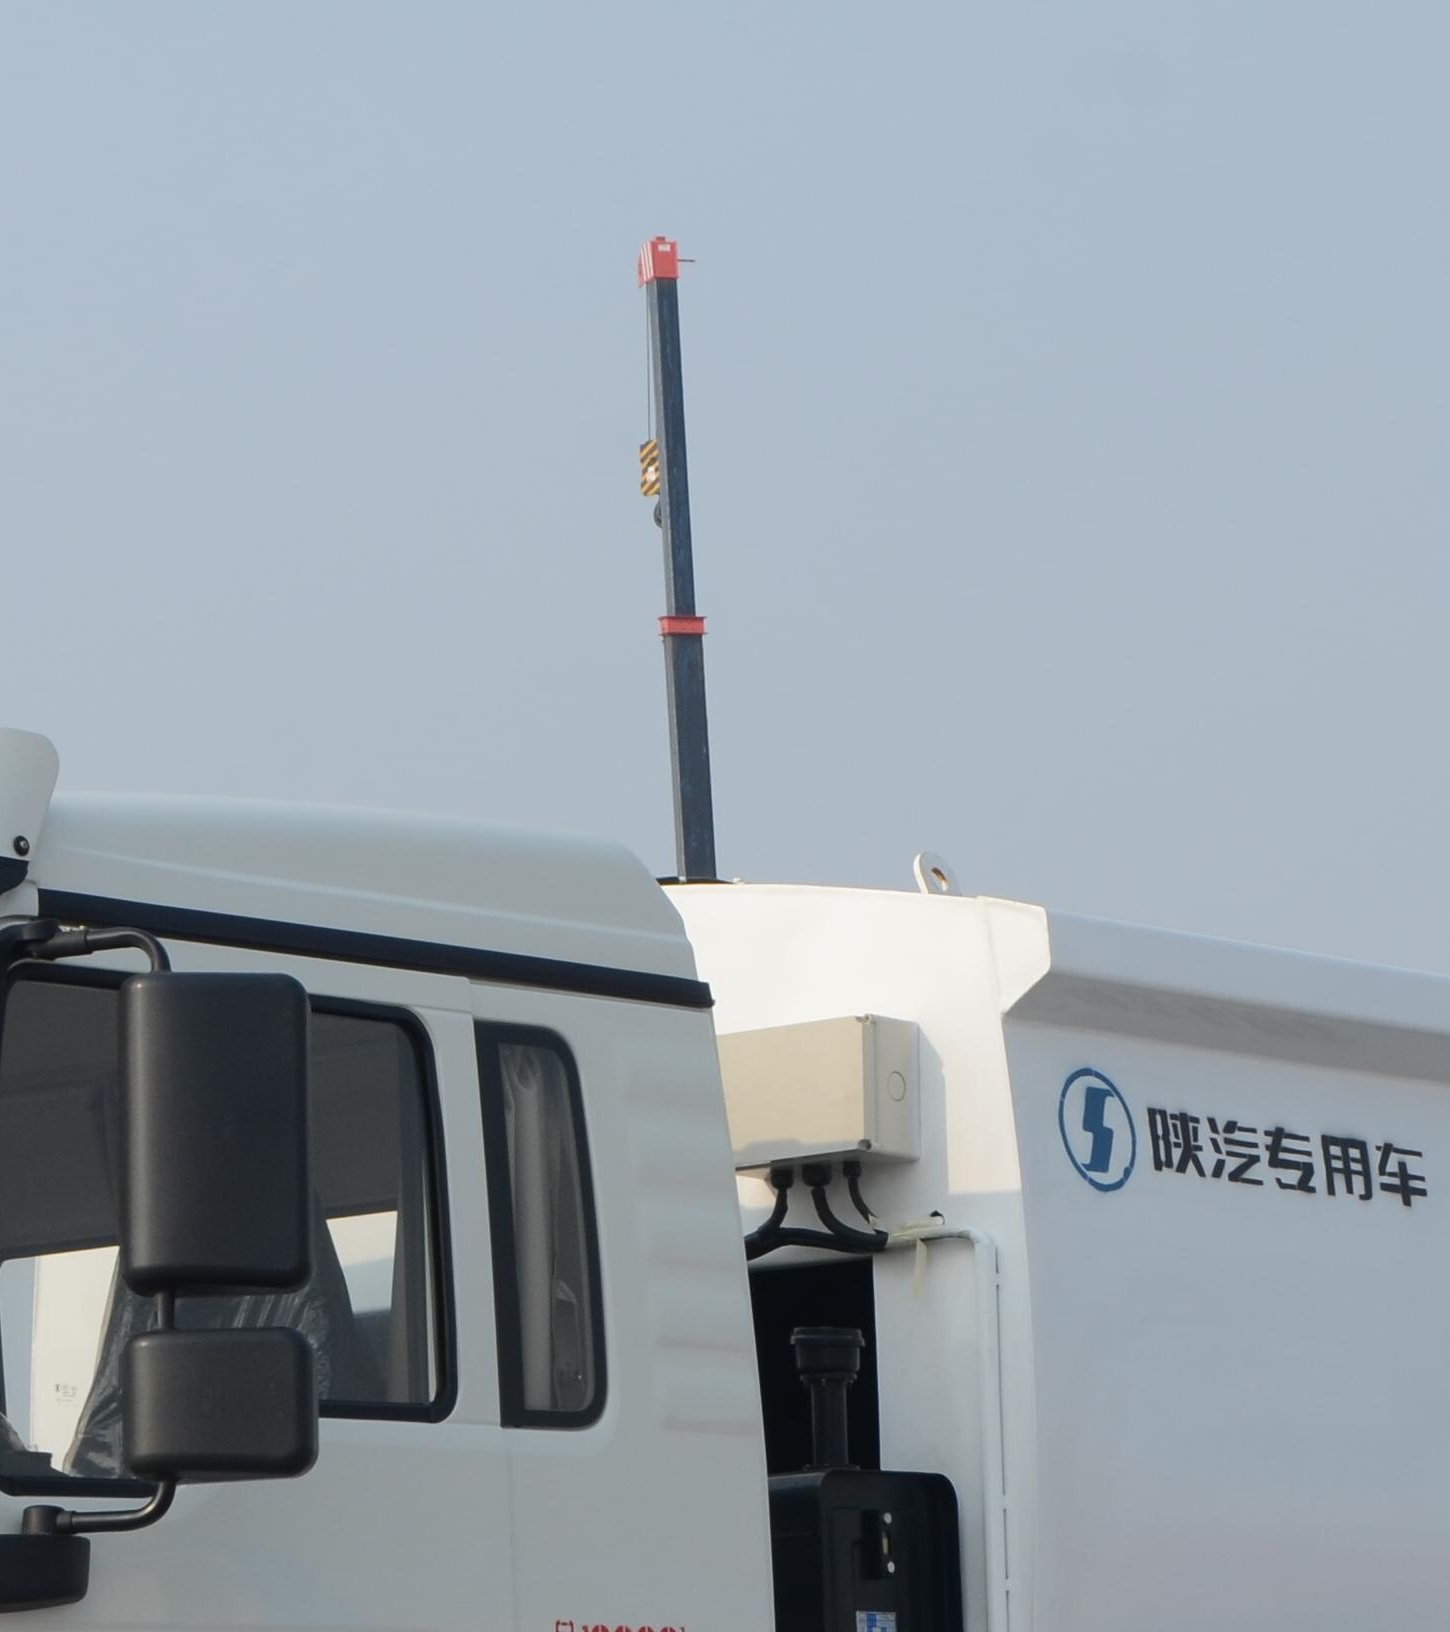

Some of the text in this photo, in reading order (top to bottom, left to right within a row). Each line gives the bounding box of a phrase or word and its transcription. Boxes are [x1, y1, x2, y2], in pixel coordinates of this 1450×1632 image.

[1146, 1106, 1429, 1208] 陕汽专用车
